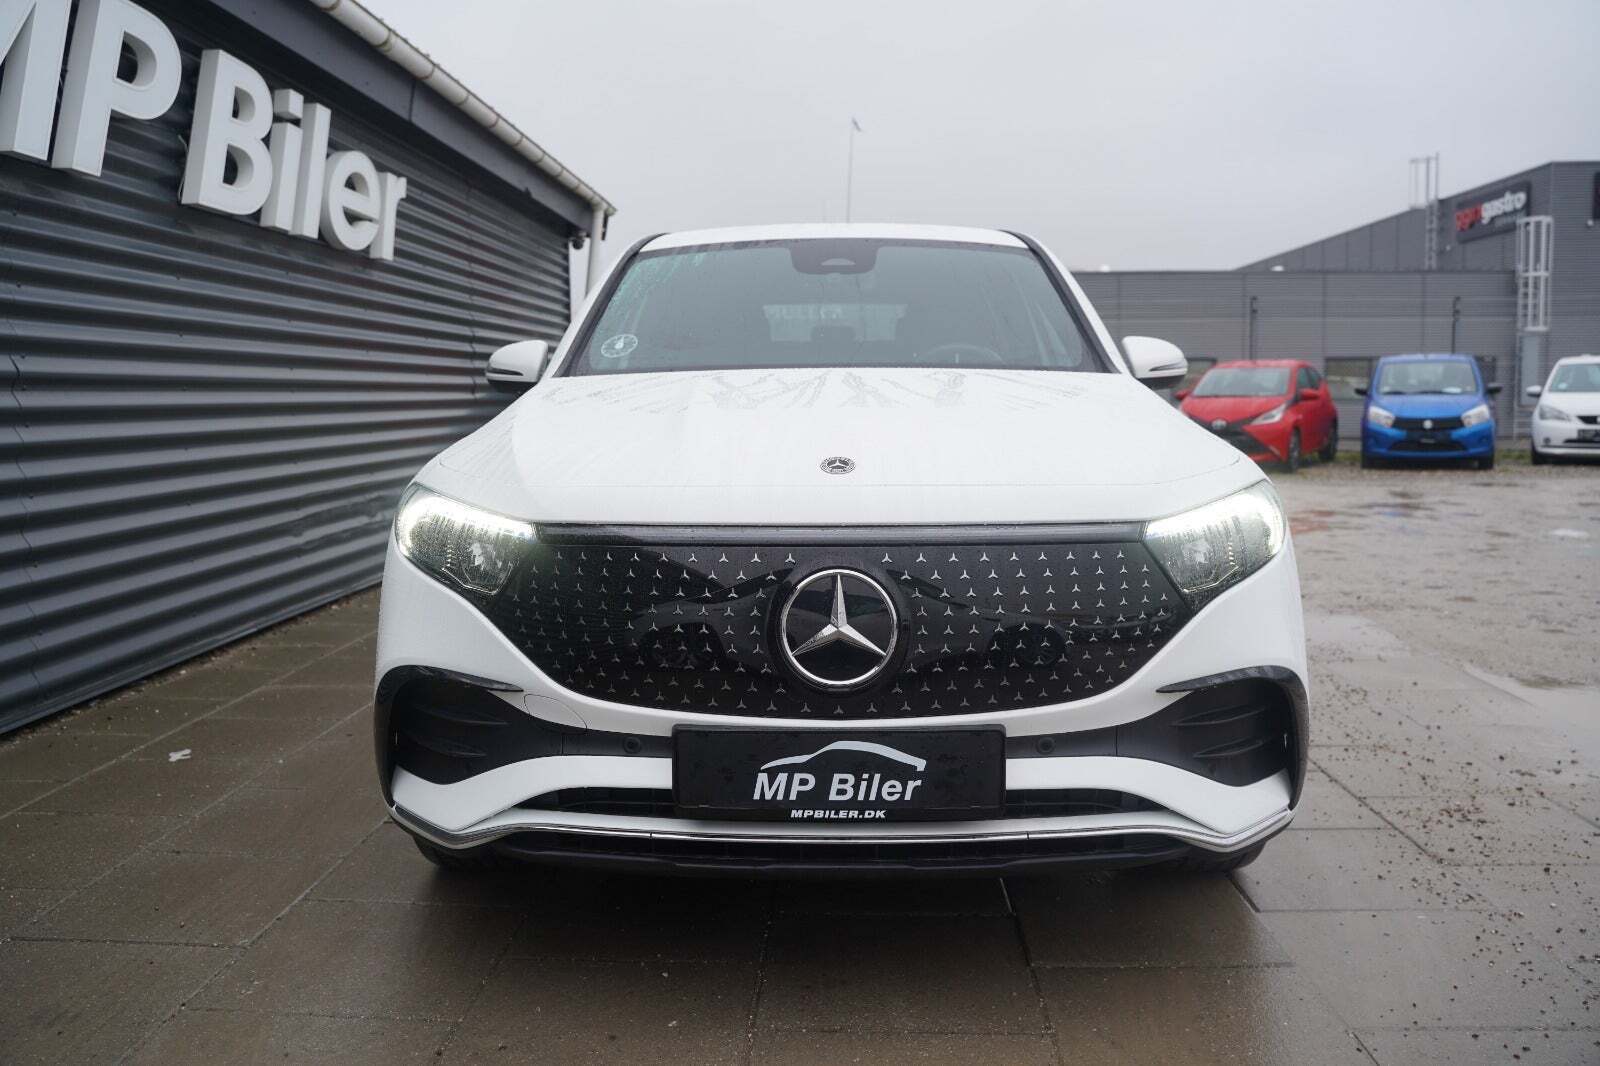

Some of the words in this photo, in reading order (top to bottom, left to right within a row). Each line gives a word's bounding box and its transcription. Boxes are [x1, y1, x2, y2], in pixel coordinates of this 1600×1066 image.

[181, 48, 407, 261] Biler
[752, 772, 816, 801] MP
[828, 772, 922, 801] Biler
[790, 808, 887, 820] MPBILER.DK
